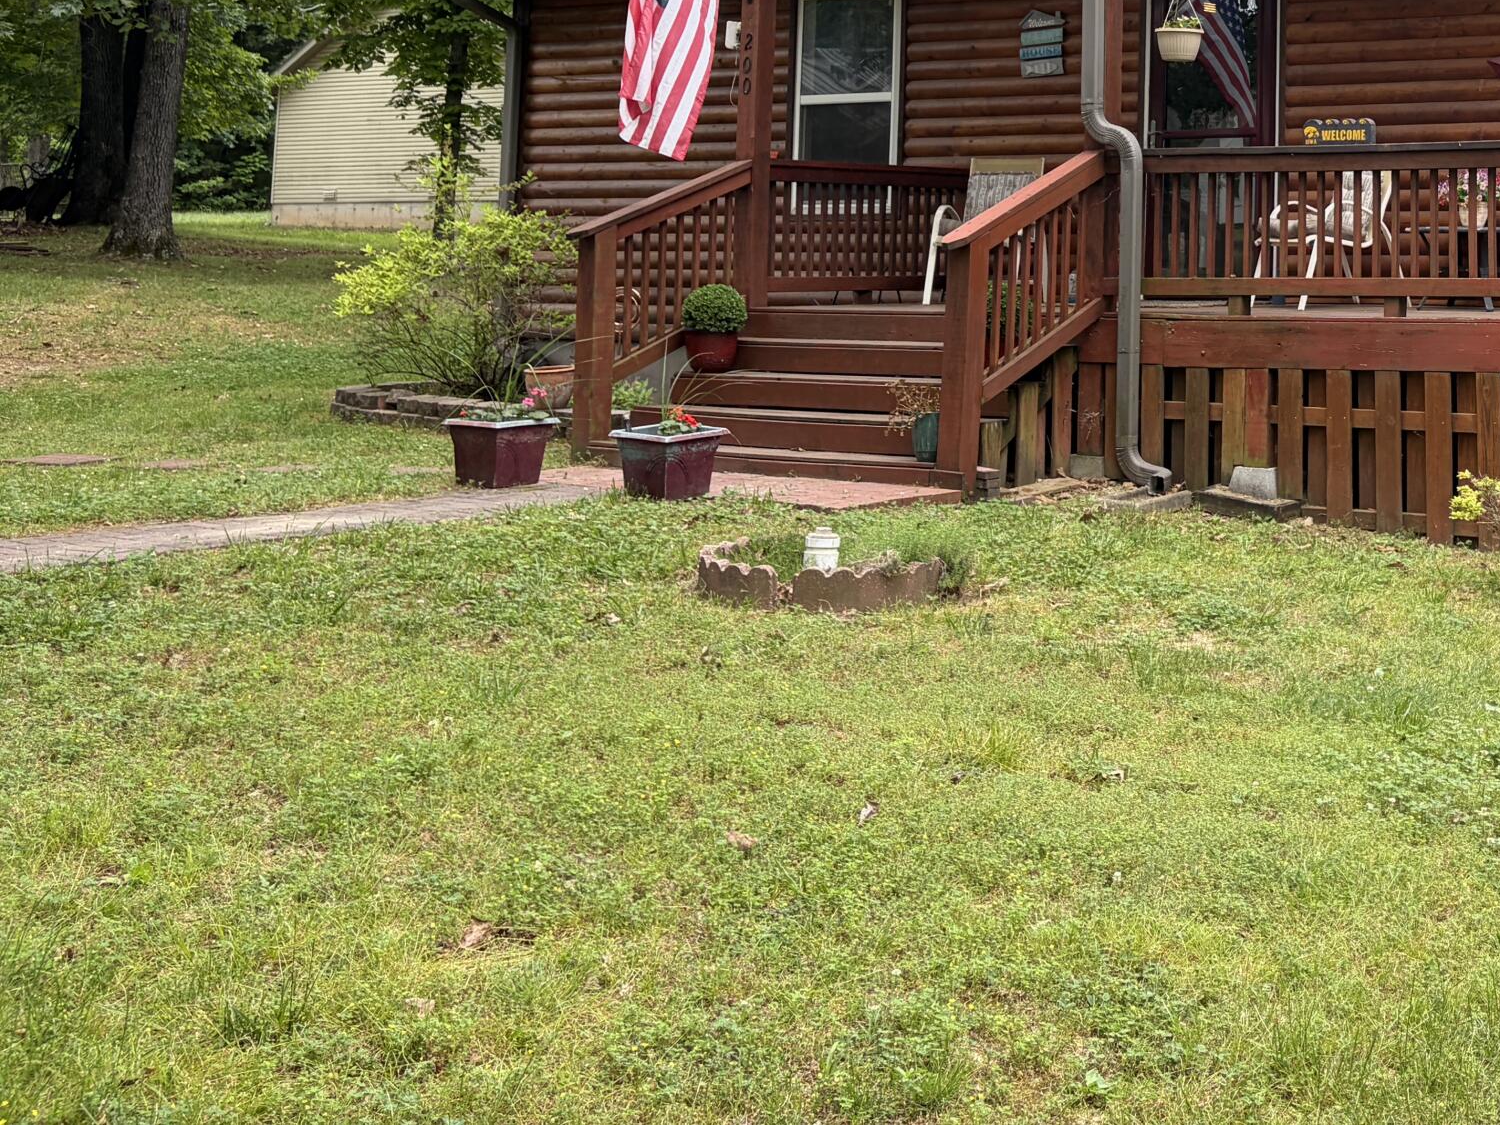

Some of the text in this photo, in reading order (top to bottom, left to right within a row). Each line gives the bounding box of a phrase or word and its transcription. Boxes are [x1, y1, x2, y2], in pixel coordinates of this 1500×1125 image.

[1022, 45, 1061, 59] HOUSE
[743, 33, 752, 95] 200
[1321, 129, 1366, 141] WELCOME
